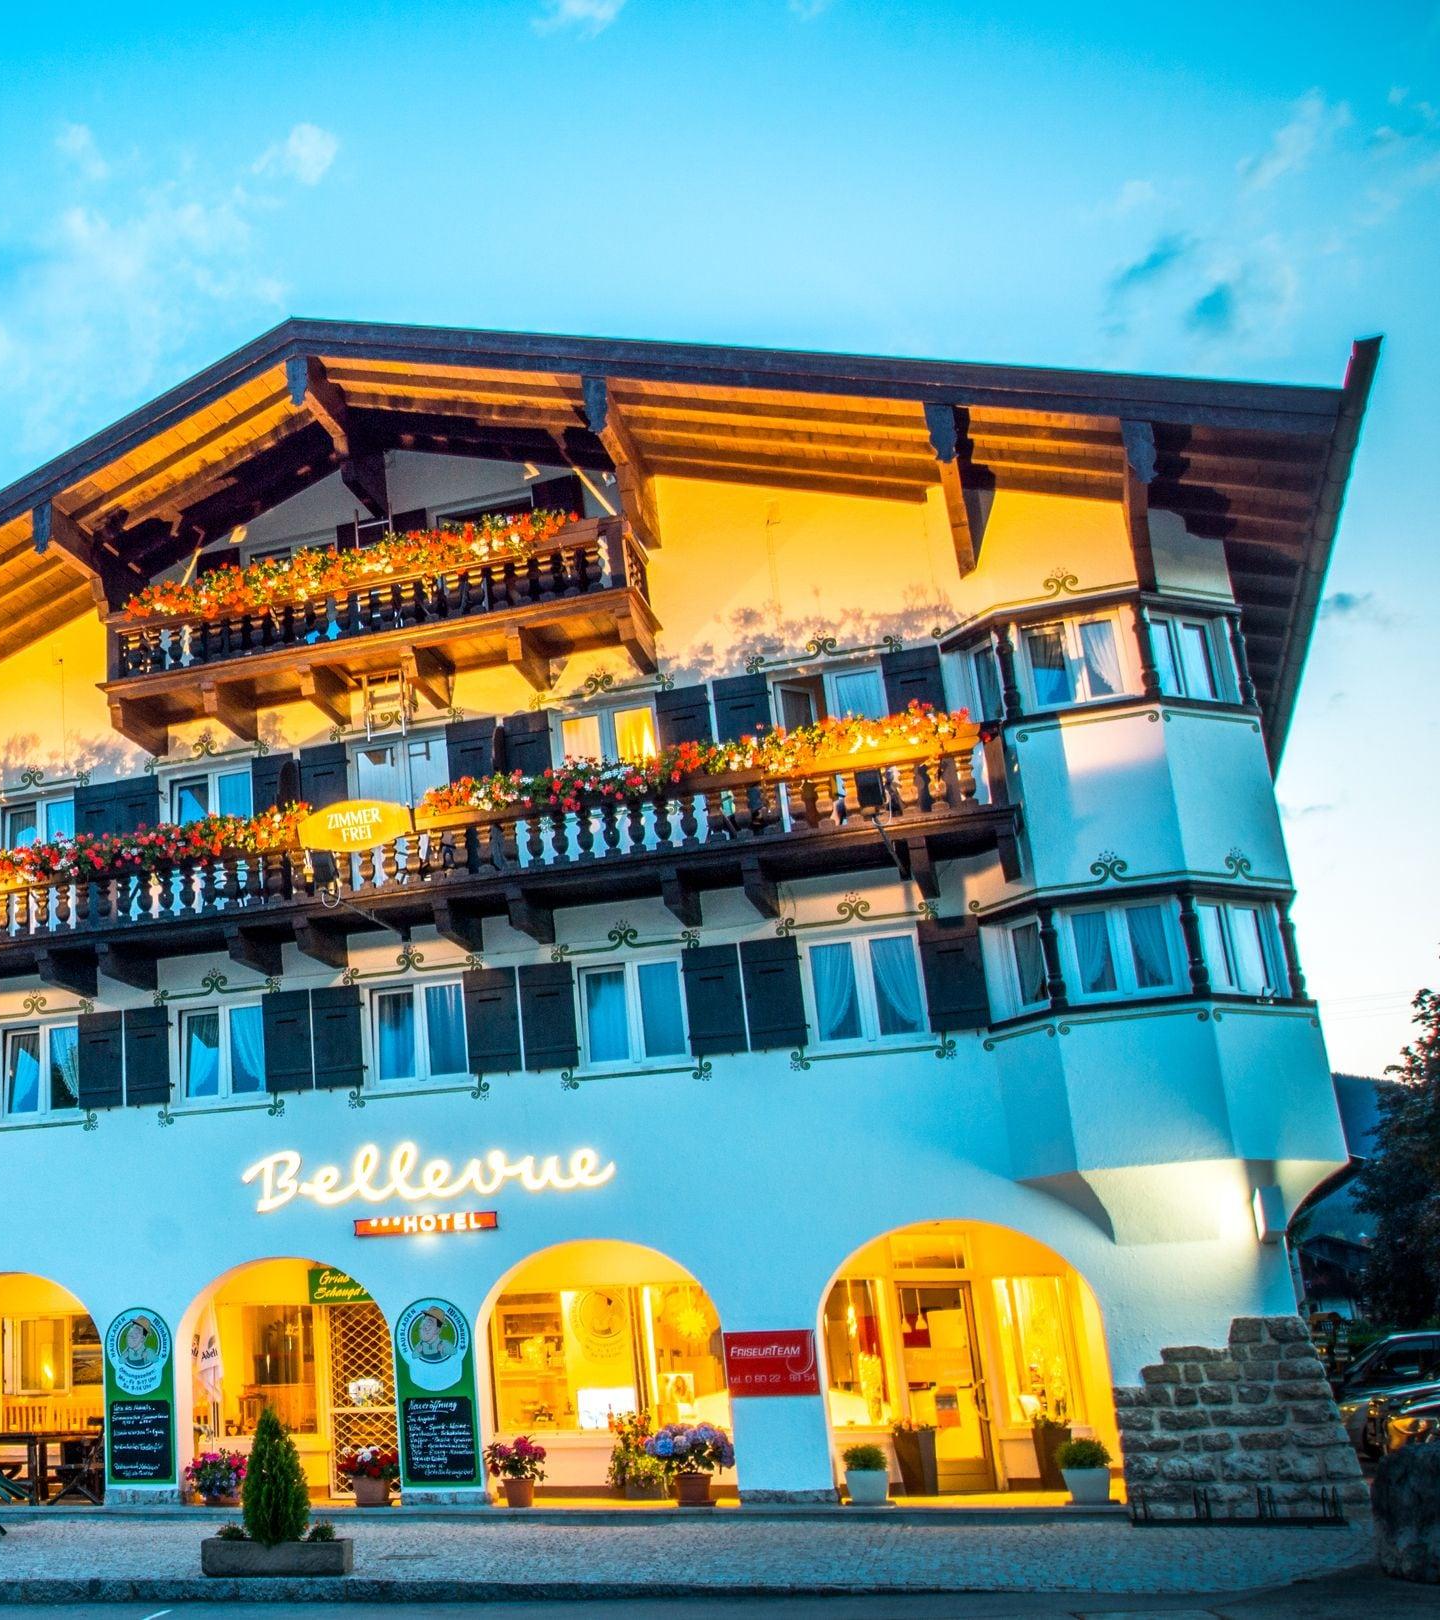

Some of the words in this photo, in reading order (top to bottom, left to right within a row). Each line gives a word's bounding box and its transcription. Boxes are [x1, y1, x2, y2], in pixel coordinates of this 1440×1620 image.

[327, 808, 382, 829] ZIMMER
[342, 825, 372, 842] FREI
[242, 1142, 615, 1213] Bellevue
[404, 1212, 481, 1232] HOTEL
[110, 1316, 126, 1359] HAUSLADEN
[400, 1308, 416, 1353] HAUSLADEN
[767, 1374, 780, 1383] 22
[408, 1400, 458, 1412] Neueröffnung
